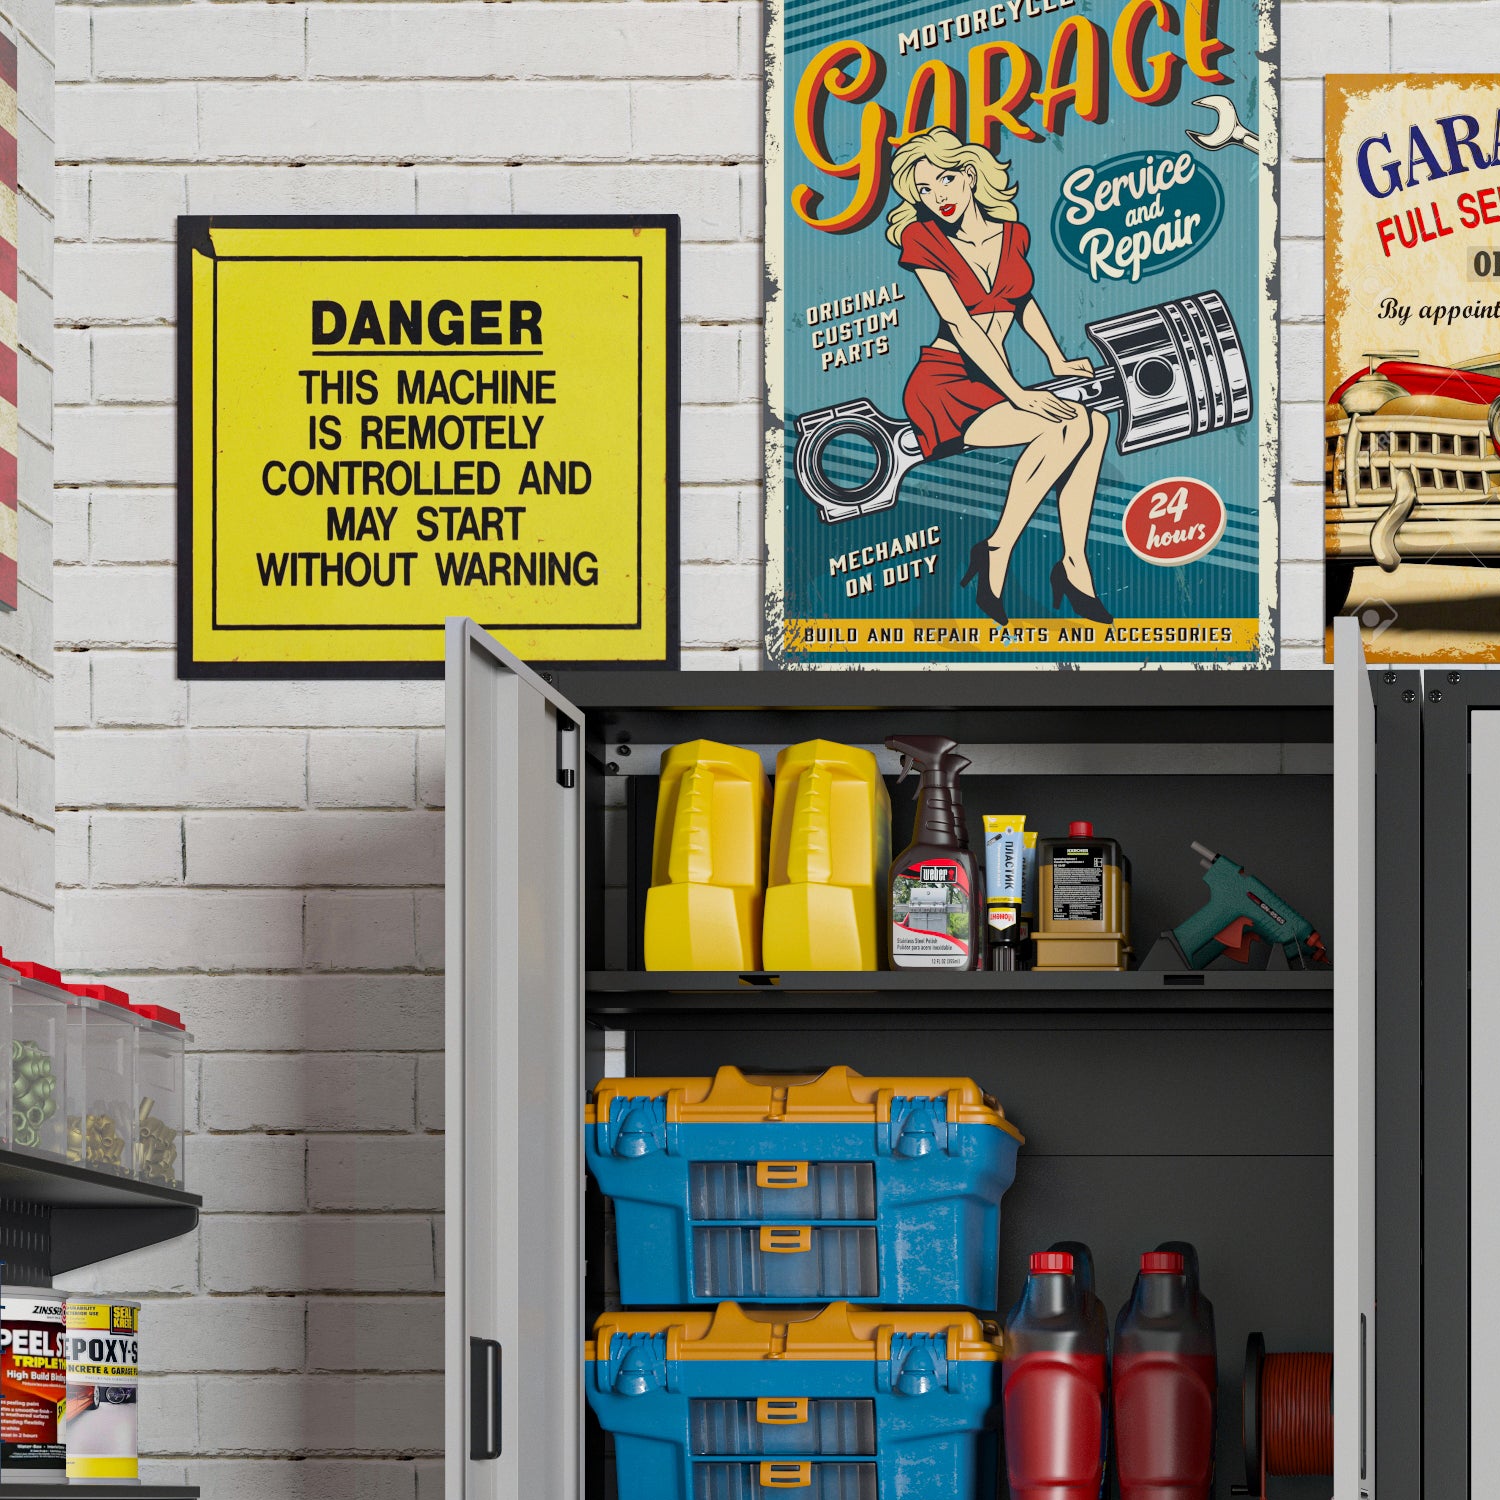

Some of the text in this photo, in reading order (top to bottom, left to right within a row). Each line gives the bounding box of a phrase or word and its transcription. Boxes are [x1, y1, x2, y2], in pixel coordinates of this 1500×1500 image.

[791, 0, 1235, 234] GARAGE
[1062, 153, 1195, 225] Service
[1125, 193, 1164, 228] and
[1079, 209, 1201, 283] Repair
[1376, 204, 1454, 258] FULL
[806, 282, 905, 326] ORIGINAL
[1377, 297, 1412, 326] By
[311, 299, 544, 346] DANGER
[811, 309, 899, 350] CUSTOM
[821, 335, 889, 371] PARTS
[298, 369, 557, 405] THIS MACHINE
[308, 415, 545, 451] IS REMOTELY
[261, 460, 592, 496] CONTROLLED AND
[1148, 486, 1189, 523] 24
[326, 506, 526, 541] MAY START
[1146, 521, 1206, 551] hours
[256, 551, 600, 587] WITHOUT WARNING
[829, 526, 941, 576] MECHANIC
[845, 555, 938, 599] ON DUTY
[803, 627, 1233, 645] BUILD AND REPAIR PARTS AND ACCESSORIES
[922, 867, 948, 881] weber
[1005, 841, 1014, 889] ПЛАСТИК
[0, 1328, 55, 1357] PEEL
[7, 1370, 50, 1381] High Build
[12, 1355, 59, 1369] TRIPLE
